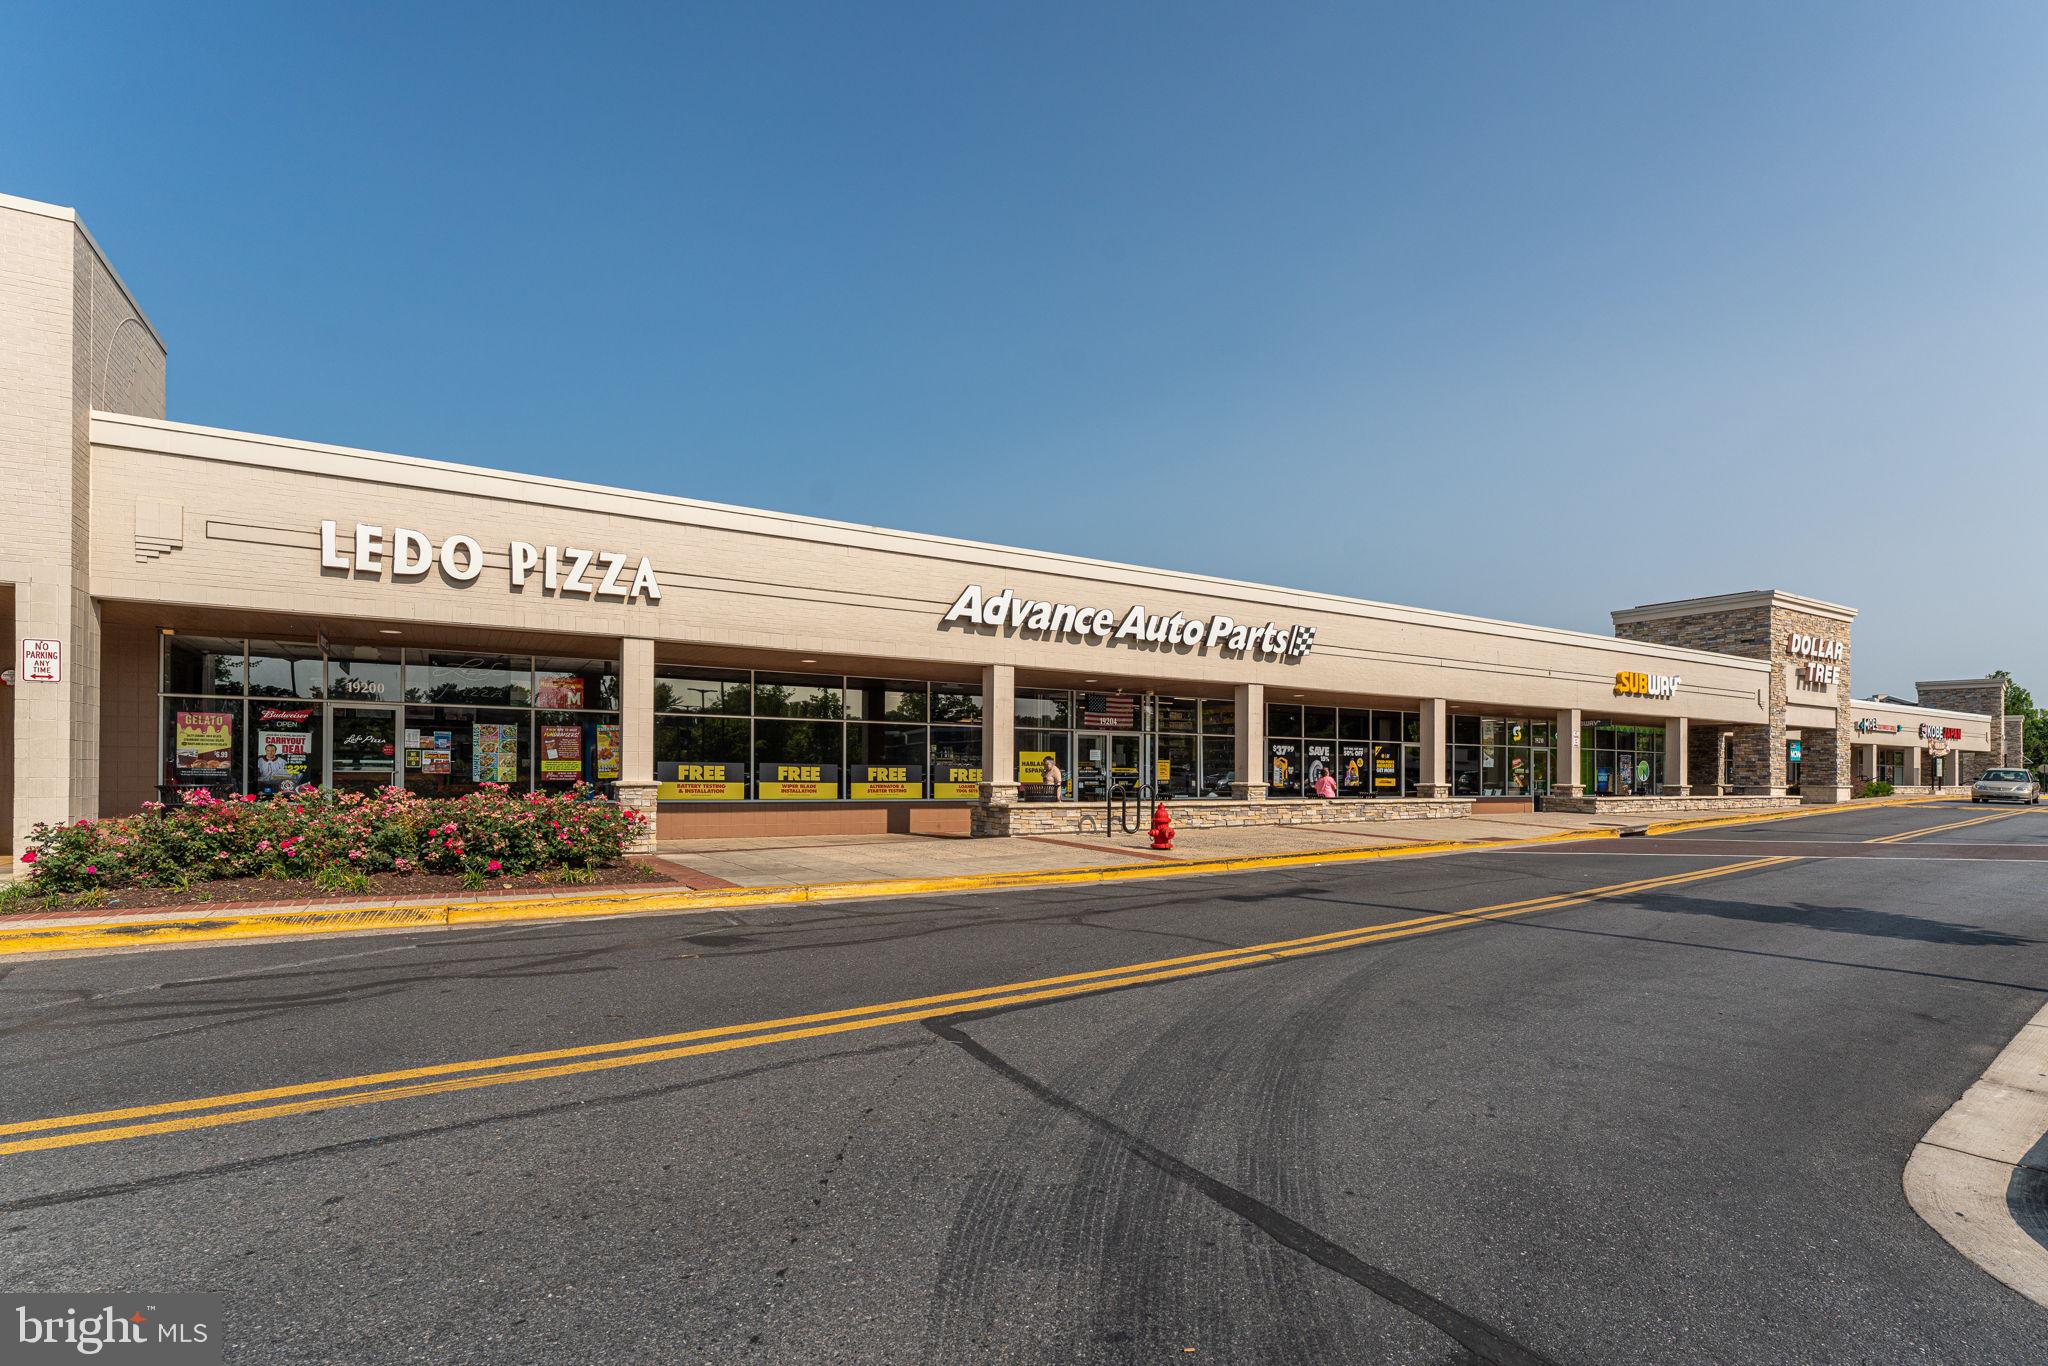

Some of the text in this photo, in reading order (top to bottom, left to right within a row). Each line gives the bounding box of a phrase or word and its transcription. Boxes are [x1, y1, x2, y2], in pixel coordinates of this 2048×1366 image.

[320, 520, 662, 599] LEDO PIZZA
[945, 584, 1290, 654] Advance Auto Parts
[35, 642, 49, 650] NO
[1790, 633, 1844, 660] DOLLAR
[26, 651, 58, 659] PARKING
[1807, 662, 1841, 685] TREE
[347, 682, 385, 693] 19200
[1613, 671, 1681, 697] SUBWAY
[185, 714, 223, 725] GELATO
[261, 709, 309, 719] Budweiser
[276, 720, 298, 728] OPEN
[1927, 725, 1962, 740] KOBE JAPAN
[265, 736, 306, 745] CARRYOUT
[282, 745, 305, 754] DEAL
[1309, 746, 1330, 756] SAVE
[678, 765, 726, 781] FREE
[777, 765, 821, 781] FREE
[867, 767, 907, 782] FREE
[950, 768, 982, 782] FREE
